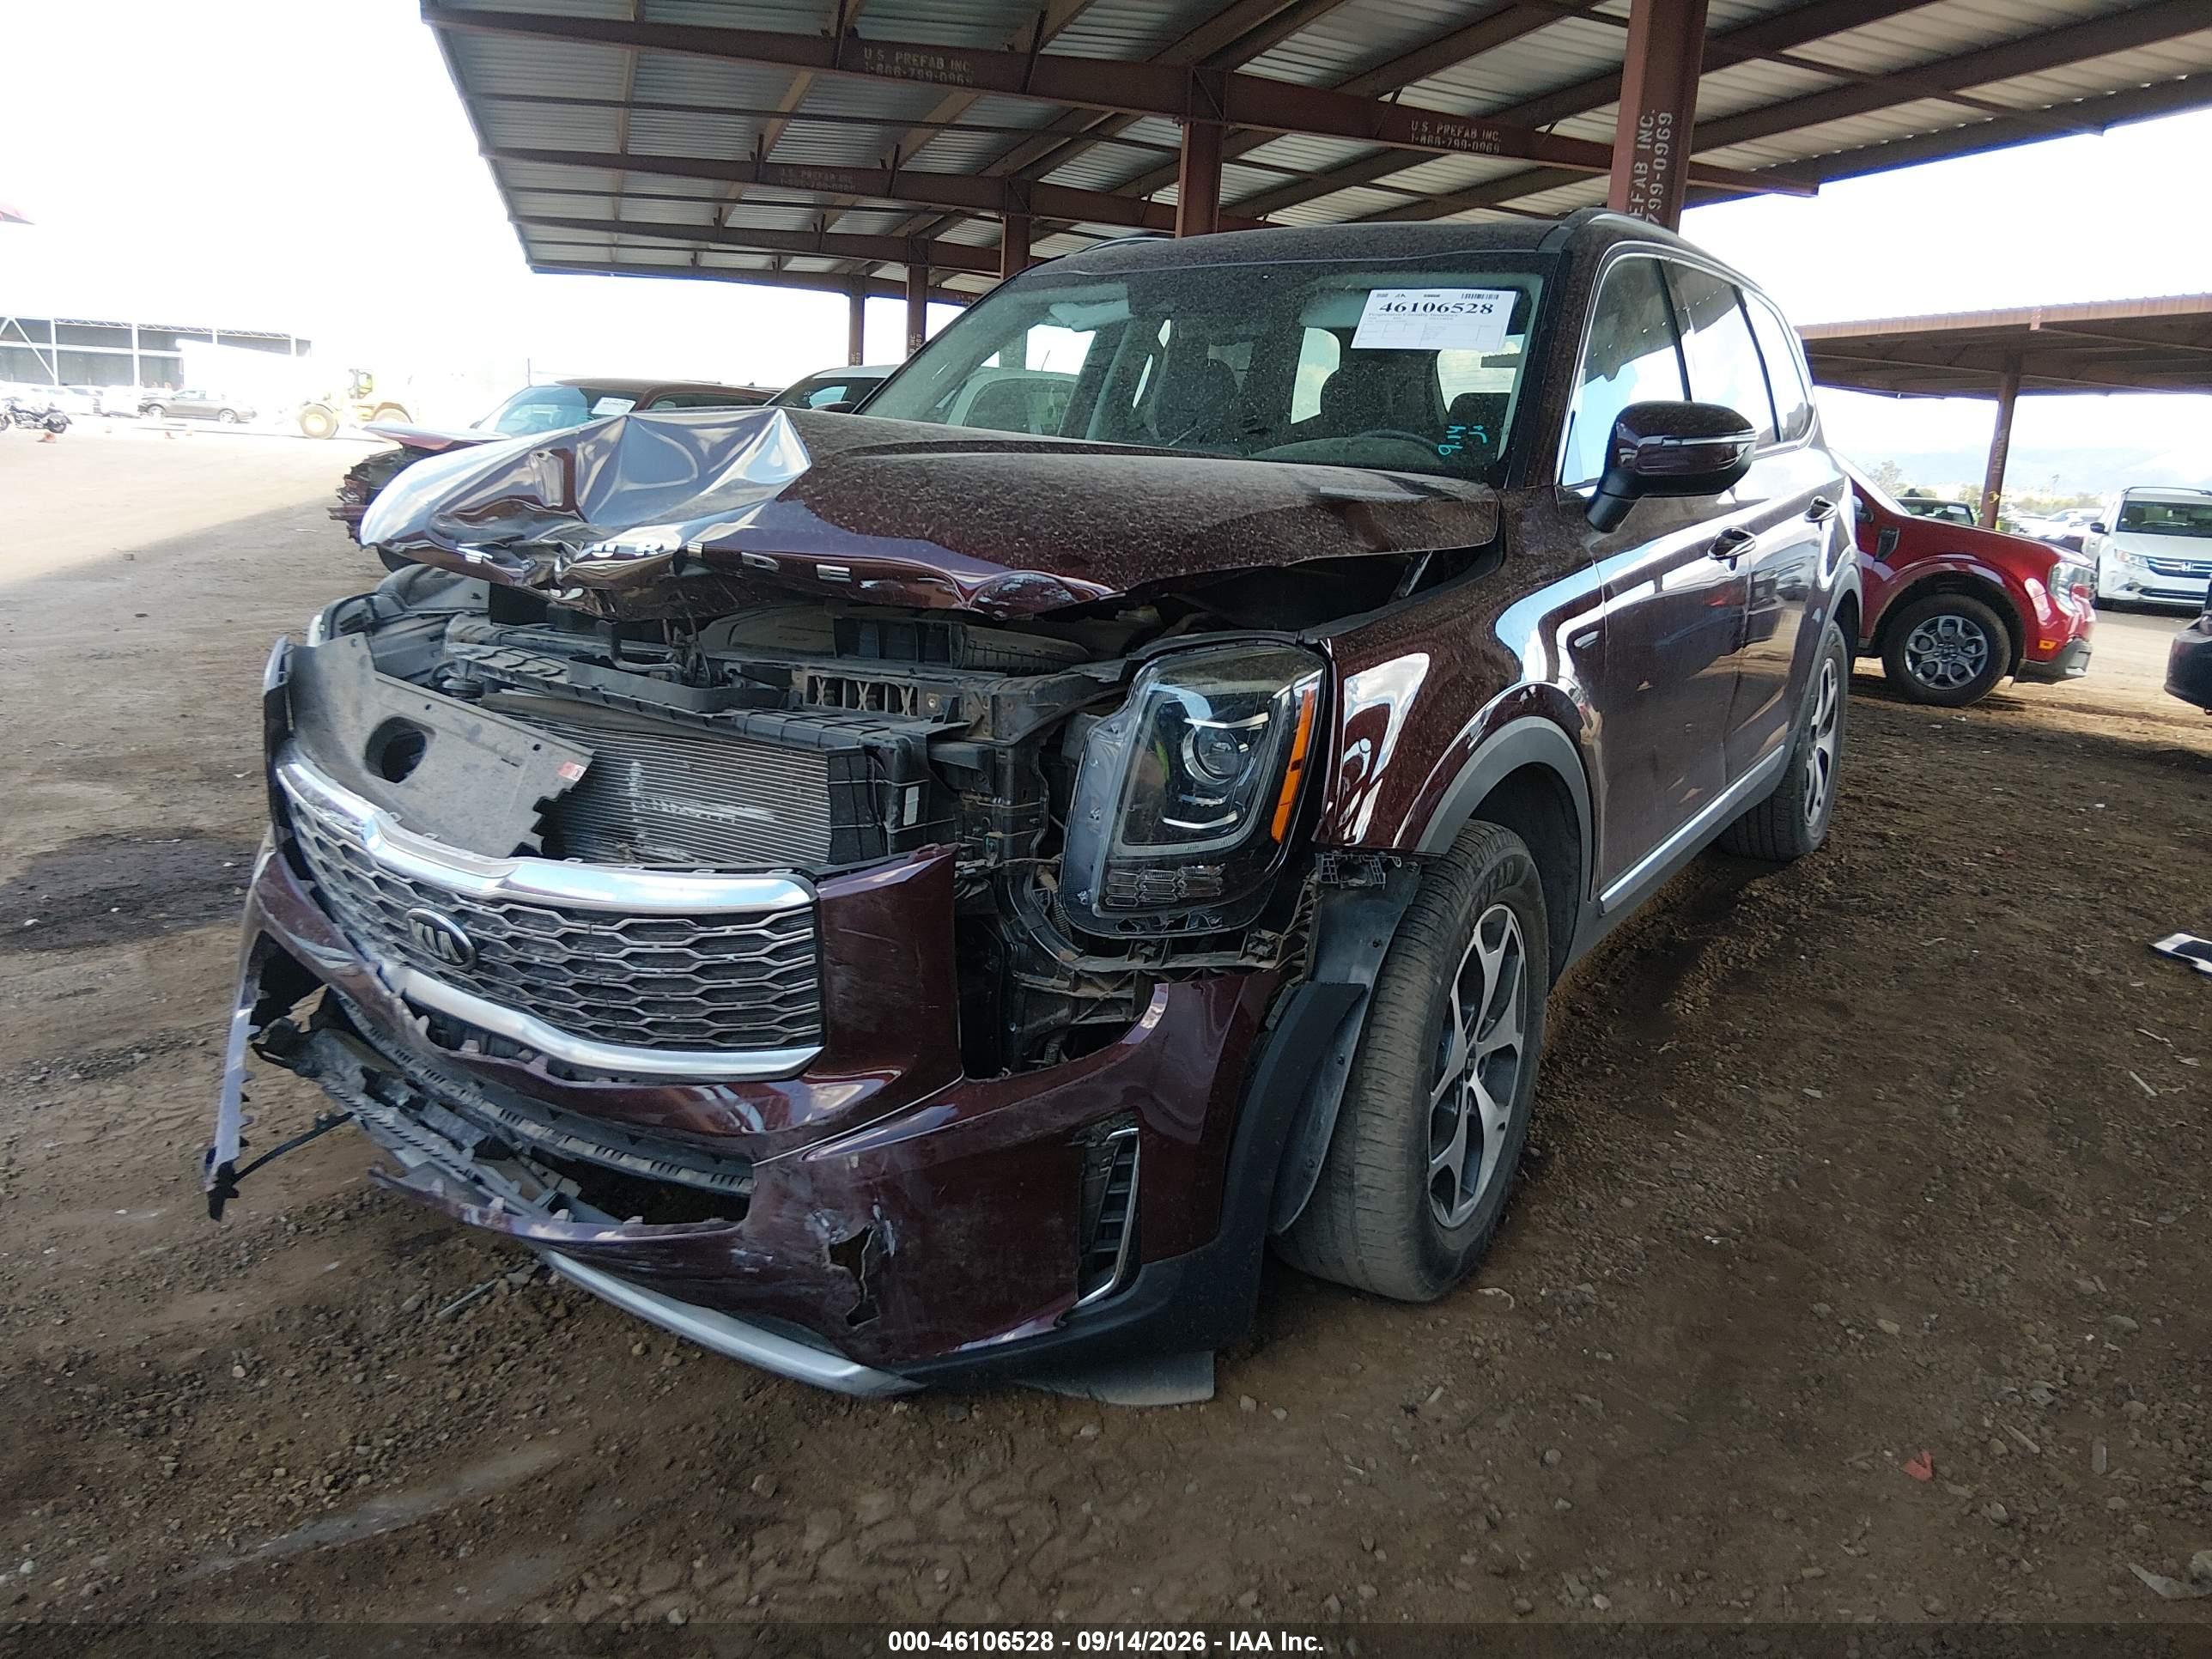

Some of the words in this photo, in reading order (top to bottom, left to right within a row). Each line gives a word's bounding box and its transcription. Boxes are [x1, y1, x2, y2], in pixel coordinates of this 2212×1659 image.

[895, 51, 945, 70] PREFAB
[1436, 122, 1479, 139] PREFAB
[1482, 130, 1502, 143] INC.
[1636, 108, 1656, 150] INC.
[1378, 301, 1494, 314] 46106528
